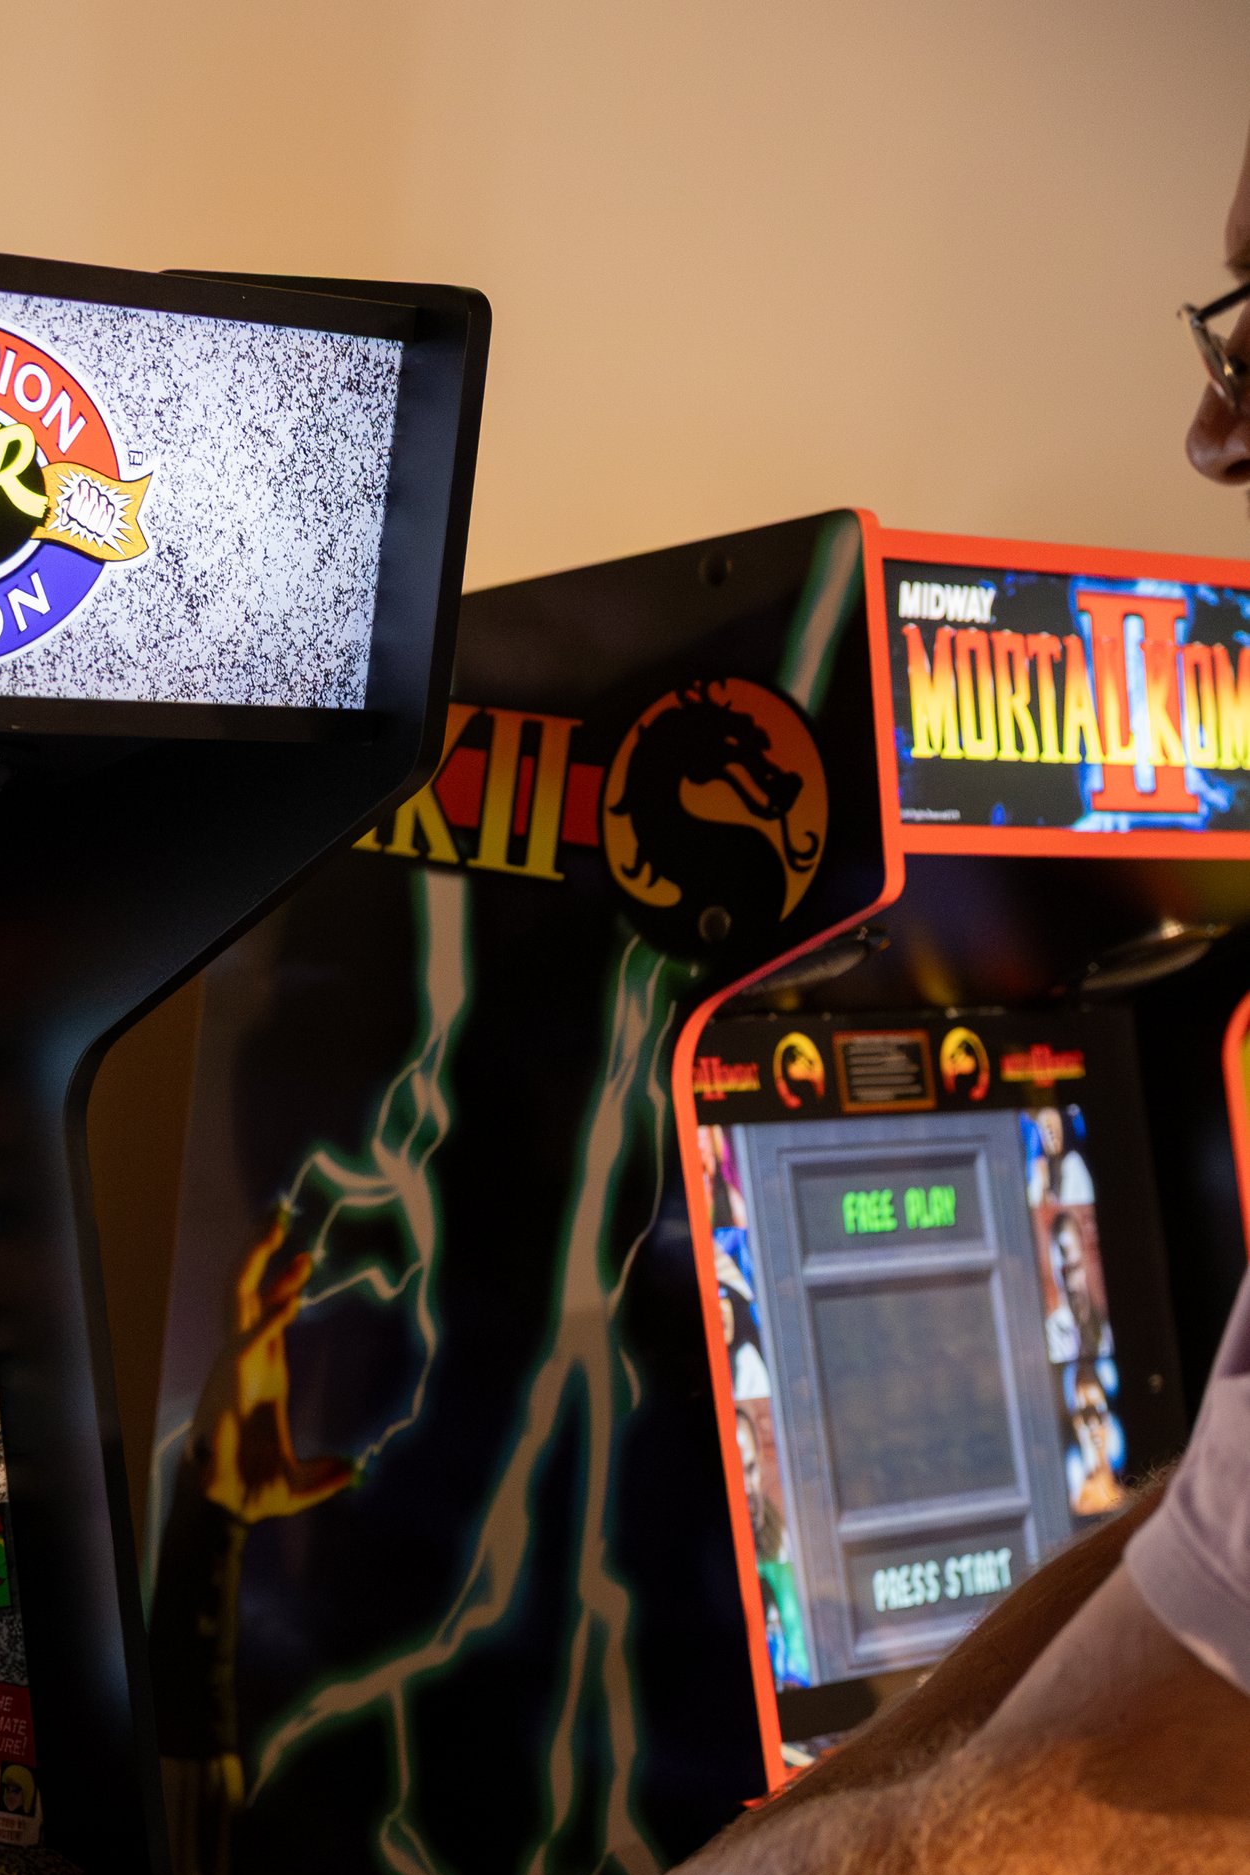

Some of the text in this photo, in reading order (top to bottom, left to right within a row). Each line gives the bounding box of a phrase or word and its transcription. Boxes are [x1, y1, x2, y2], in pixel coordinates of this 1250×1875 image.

[899, 580, 996, 624] MIDWAY
[902, 622, 1140, 766] MORTAL
[354, 702, 584, 882] KII
[842, 1188, 898, 1234] FREE
[872, 1547, 1012, 1613] PRESS START
